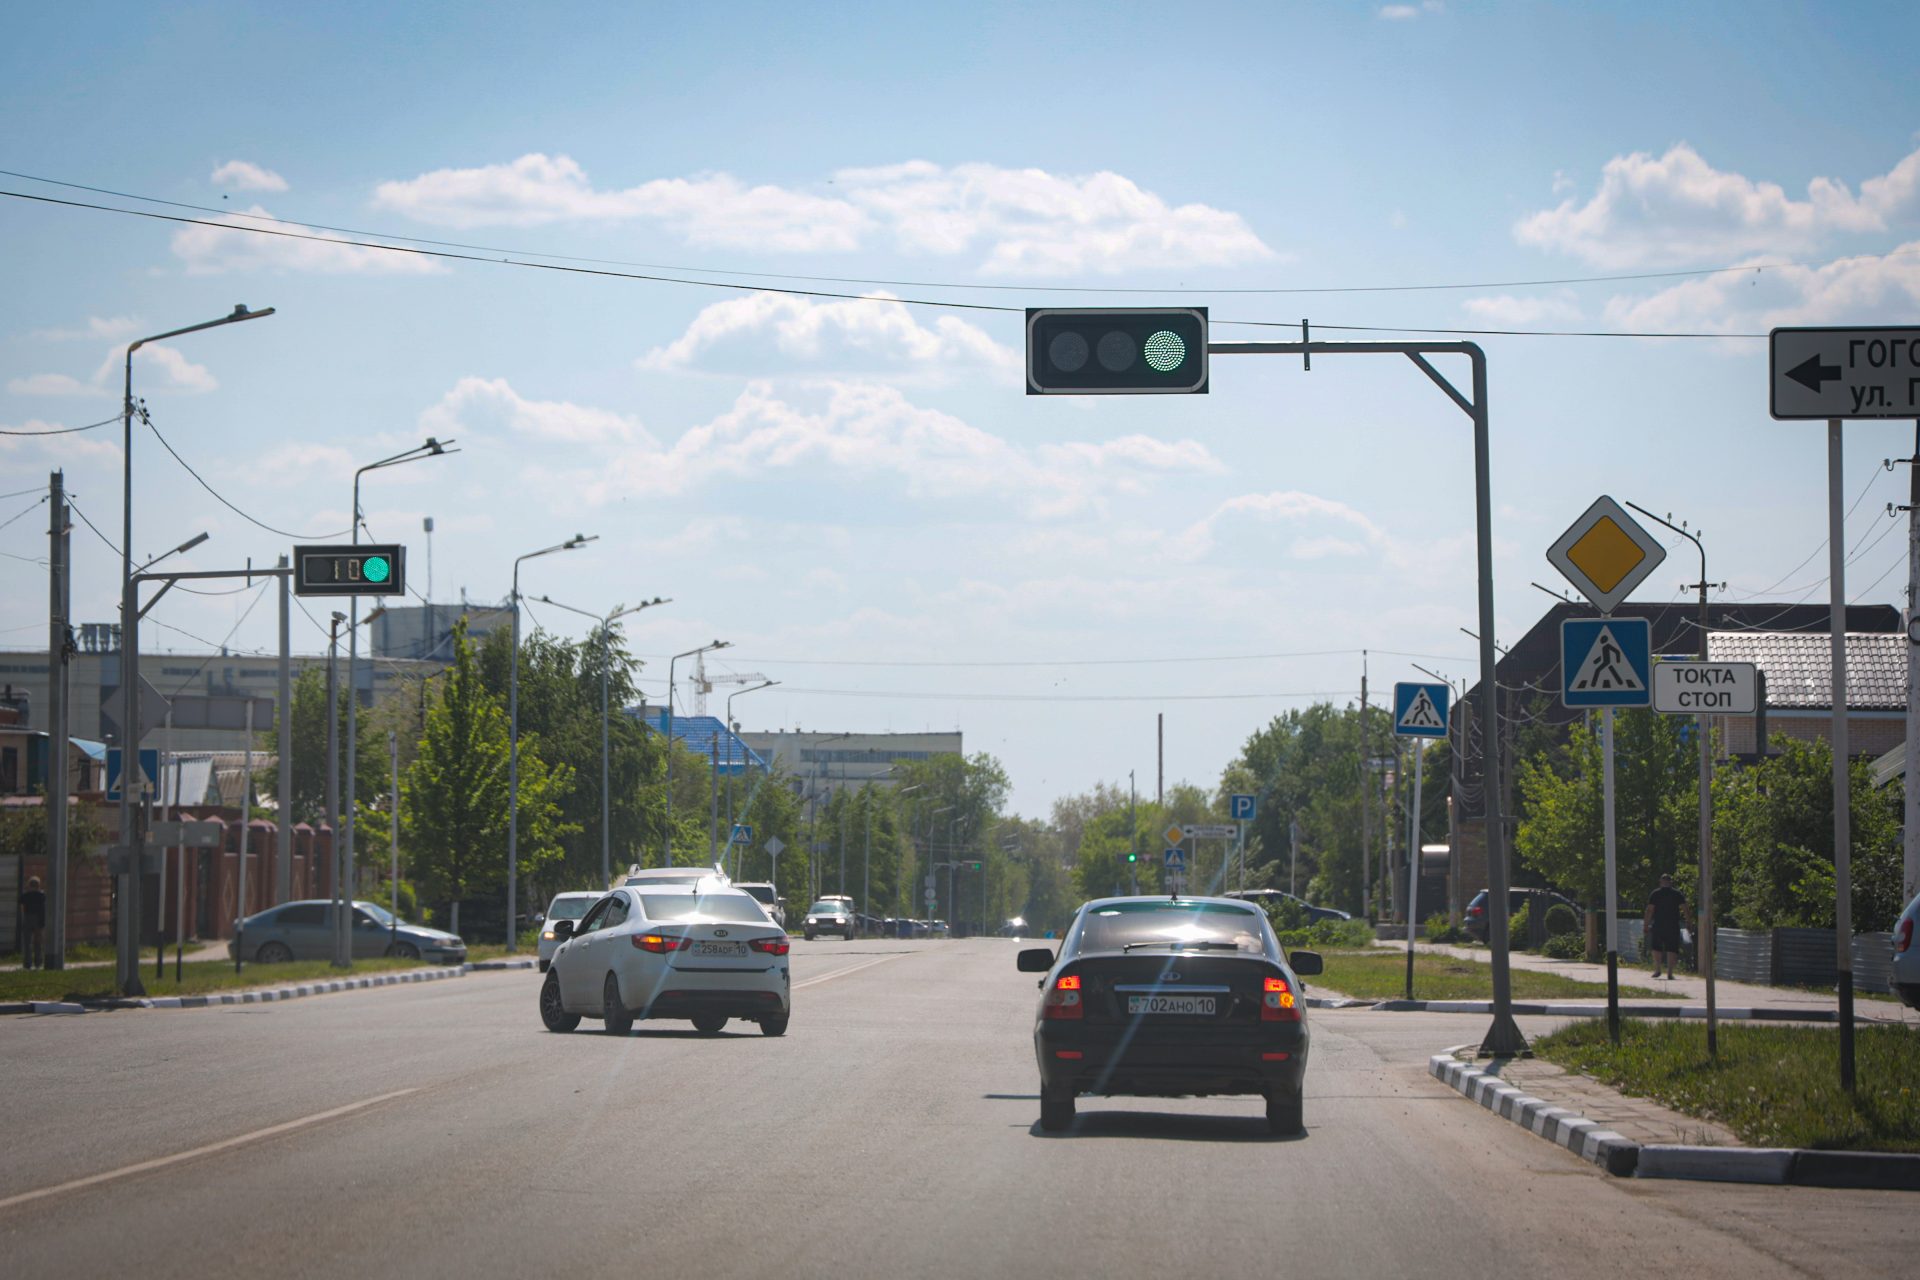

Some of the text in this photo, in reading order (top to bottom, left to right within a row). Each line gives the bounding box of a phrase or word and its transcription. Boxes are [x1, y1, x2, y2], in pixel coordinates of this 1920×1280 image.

[1850, 386, 1892, 414] ул.
[335, 559, 360, 579] 10
[1673, 668, 1736, 686] ТОҚТА
[1678, 692, 1731, 707] СТОП
[1237, 798, 1251, 817] P
[1198, 999, 1214, 1014] 10
